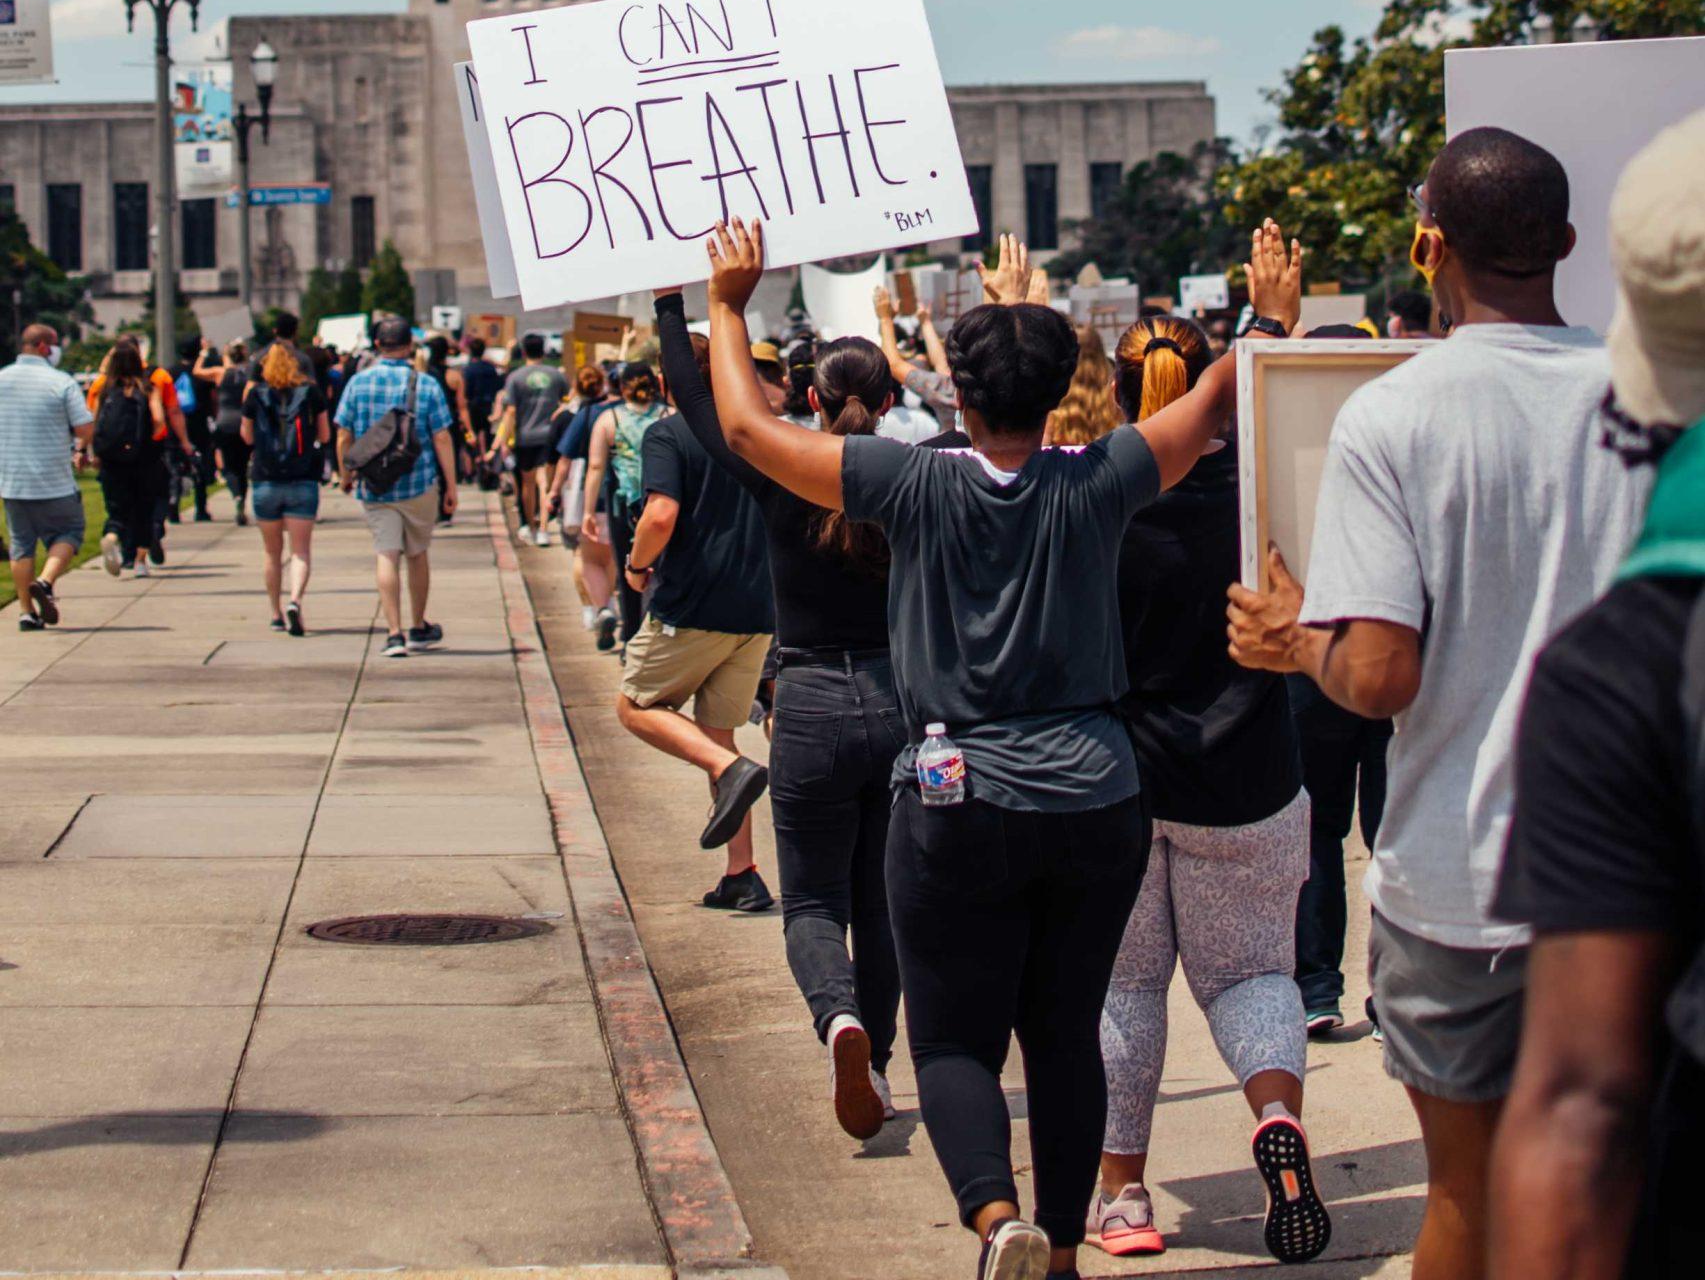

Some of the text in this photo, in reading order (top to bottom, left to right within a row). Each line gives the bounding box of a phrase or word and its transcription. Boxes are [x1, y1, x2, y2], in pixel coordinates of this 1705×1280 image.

[511, 25, 547, 85] I
[505, 64, 938, 259] BREATHE.
[884, 207, 933, 232] #BLM
